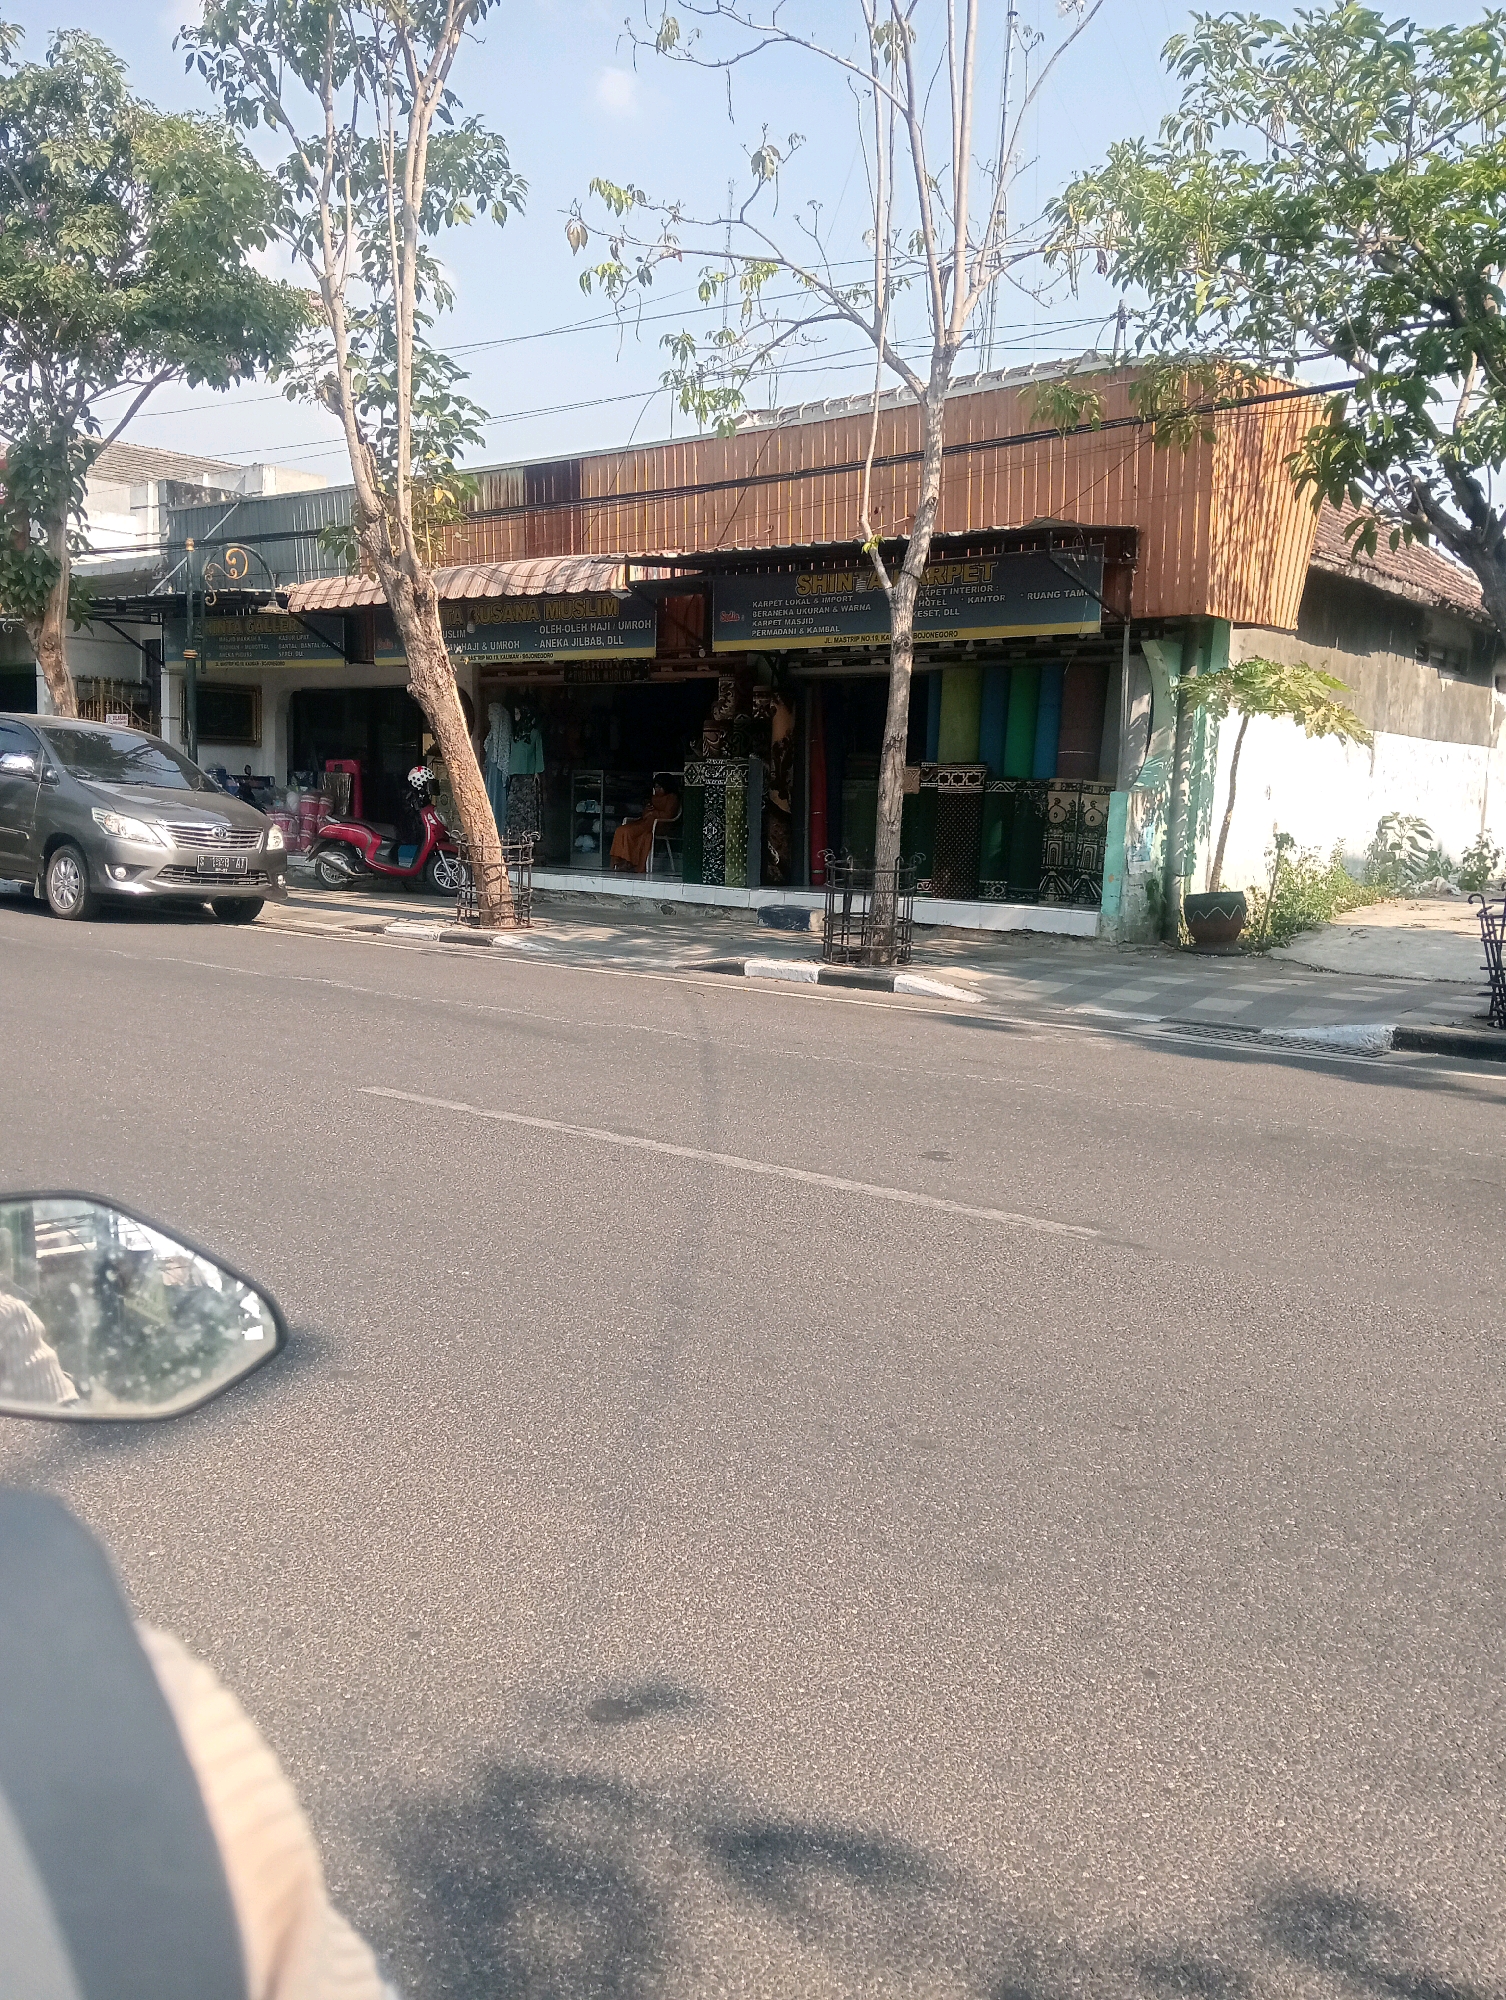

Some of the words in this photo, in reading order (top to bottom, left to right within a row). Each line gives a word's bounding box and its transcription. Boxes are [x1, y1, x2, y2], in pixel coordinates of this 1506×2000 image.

[795, 571, 886, 597] SHINTA
[892, 561, 999, 588] ARPET
[918, 588, 947, 597] ARPET
[949, 585, 993, 595] INTERIOR
[1027, 590, 1061, 600] RUANG
[752, 600, 783, 609] KARPET
[785, 599, 811, 607] LOKAL
[822, 596, 853, 604] IMPORT
[918, 598, 947, 607] HOTEL
[967, 594, 1005, 604] KANTOR
[469, 600, 540, 625] BUSANA
[544, 597, 620, 621] MUSLIM
[752, 608, 794, 618] BERANEKA
[796, 606, 830, 615] UKURAN
[832, 605, 838, 613] &
[840, 603, 871, 612] WARNA
[943, 607, 960, 616] DLL
[539, 623, 588, 635] OLEH-OLEH
[590, 622, 611, 632] HAJI
[618, 619, 652, 631] UMROH
[752, 619, 782, 628] KARPET
[784, 617, 814, 626] MASJID
[442, 629, 466, 639] USLIM
[751, 628, 797, 637] PERMADANI
[806, 625, 840, 634] KAMBAL
[913, 630, 958, 640] BOJONEGORO
[461, 642, 479, 651] HAJI
[481, 641, 488, 650] &
[490, 640, 520, 650] UMROH
[539, 638, 569, 649] ANEKA
[571, 636, 605, 647] JILBAB,
[607, 635, 624, 646] DLL
[833, 635, 860, 644] MASTRIP
